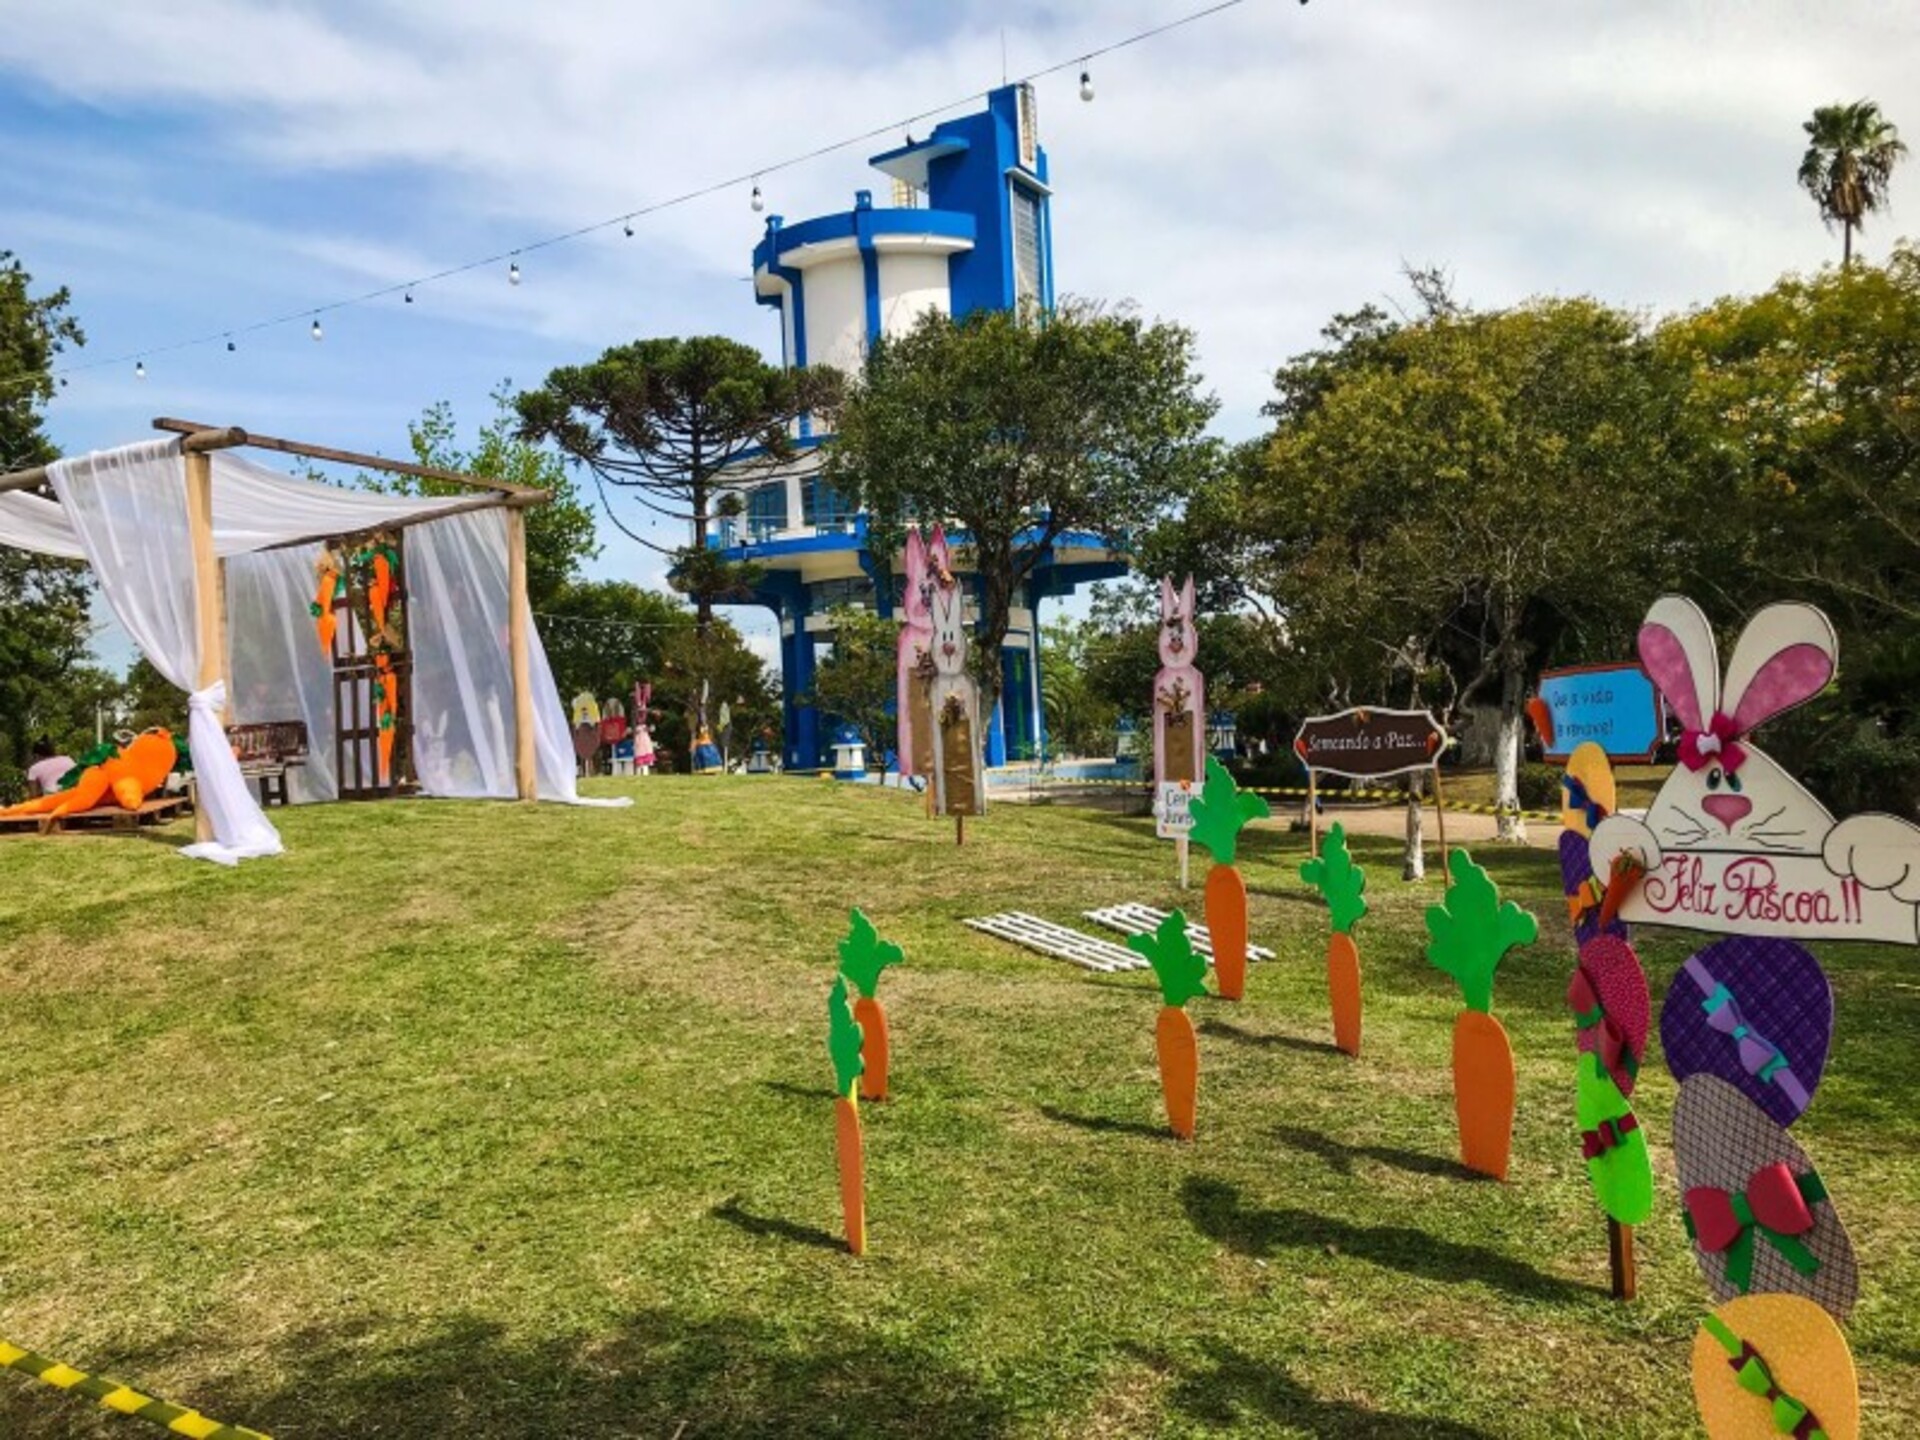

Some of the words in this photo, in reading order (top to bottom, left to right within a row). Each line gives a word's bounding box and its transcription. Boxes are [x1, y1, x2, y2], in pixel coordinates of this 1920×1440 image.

[1582, 687, 1614, 705] vida
[1308, 730, 1369, 752] Semeando
[1372, 735, 1381, 750] a
[1644, 853, 1718, 914] Feliz
